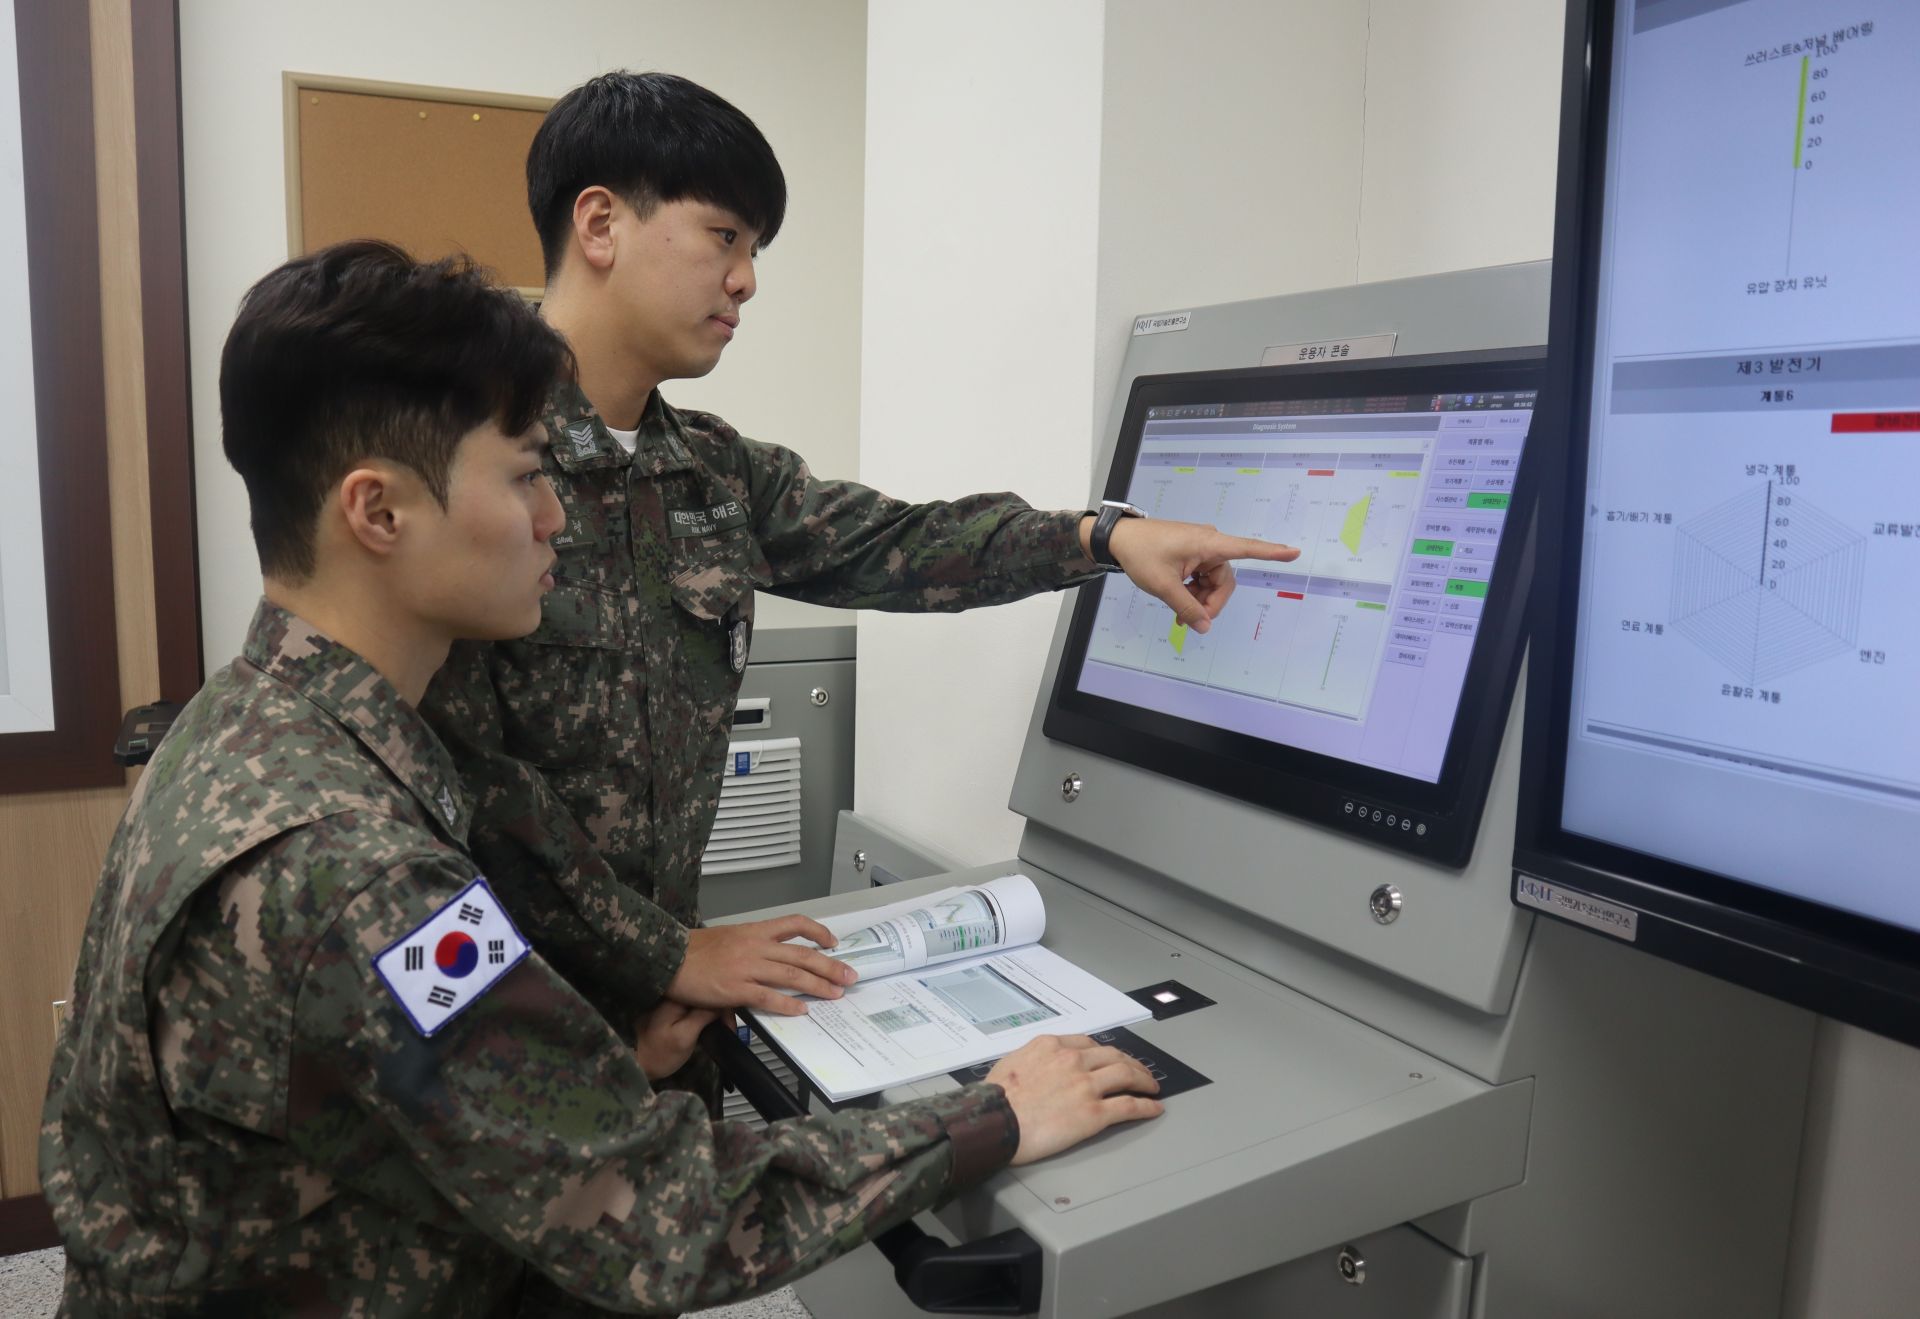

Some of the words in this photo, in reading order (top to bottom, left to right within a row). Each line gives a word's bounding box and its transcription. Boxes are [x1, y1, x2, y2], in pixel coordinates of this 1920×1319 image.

[1832, 20, 1874, 43] 베어링
[1816, 43, 1838, 58] 100
[1812, 68, 1828, 80] 80
[1810, 91, 1826, 102] 60
[1808, 114, 1824, 126] 40
[1806, 136, 1822, 148] 20
[1805, 159, 1812, 170] 0
[1746, 282, 1770, 295] 유압
[1774, 279, 1797, 292] 장치
[1803, 275, 1827, 290] 유닛
[1298, 345, 1326, 361] 운용자
[1330, 344, 1350, 358] 콘솔
[1737, 360, 1763, 375] 제3
[1769, 357, 1821, 374] 발전기
[1761, 390, 1794, 402] 계통6
[1278, 422, 1296, 432] System
[1745, 464, 1769, 476] 냉각
[1774, 464, 1796, 476] 계통
[1780, 476, 1800, 486] 100
[1777, 497, 1791, 506] 80
[674, 511, 707, 526] 대한민국
[712, 501, 740, 520] 해군
[1606, 511, 1649, 523] 흡기/배기
[1652, 513, 1672, 524] 계통
[702, 523, 717, 533] NAVY
[1775, 518, 1789, 527] 60
[1773, 539, 1787, 549] 40
[1772, 560, 1786, 569] 20
[1621, 620, 1641, 633] 연료
[1644, 622, 1664, 635] 계통
[1860, 649, 1886, 664] 엔진
[1759, 689, 1781, 704] 계통
